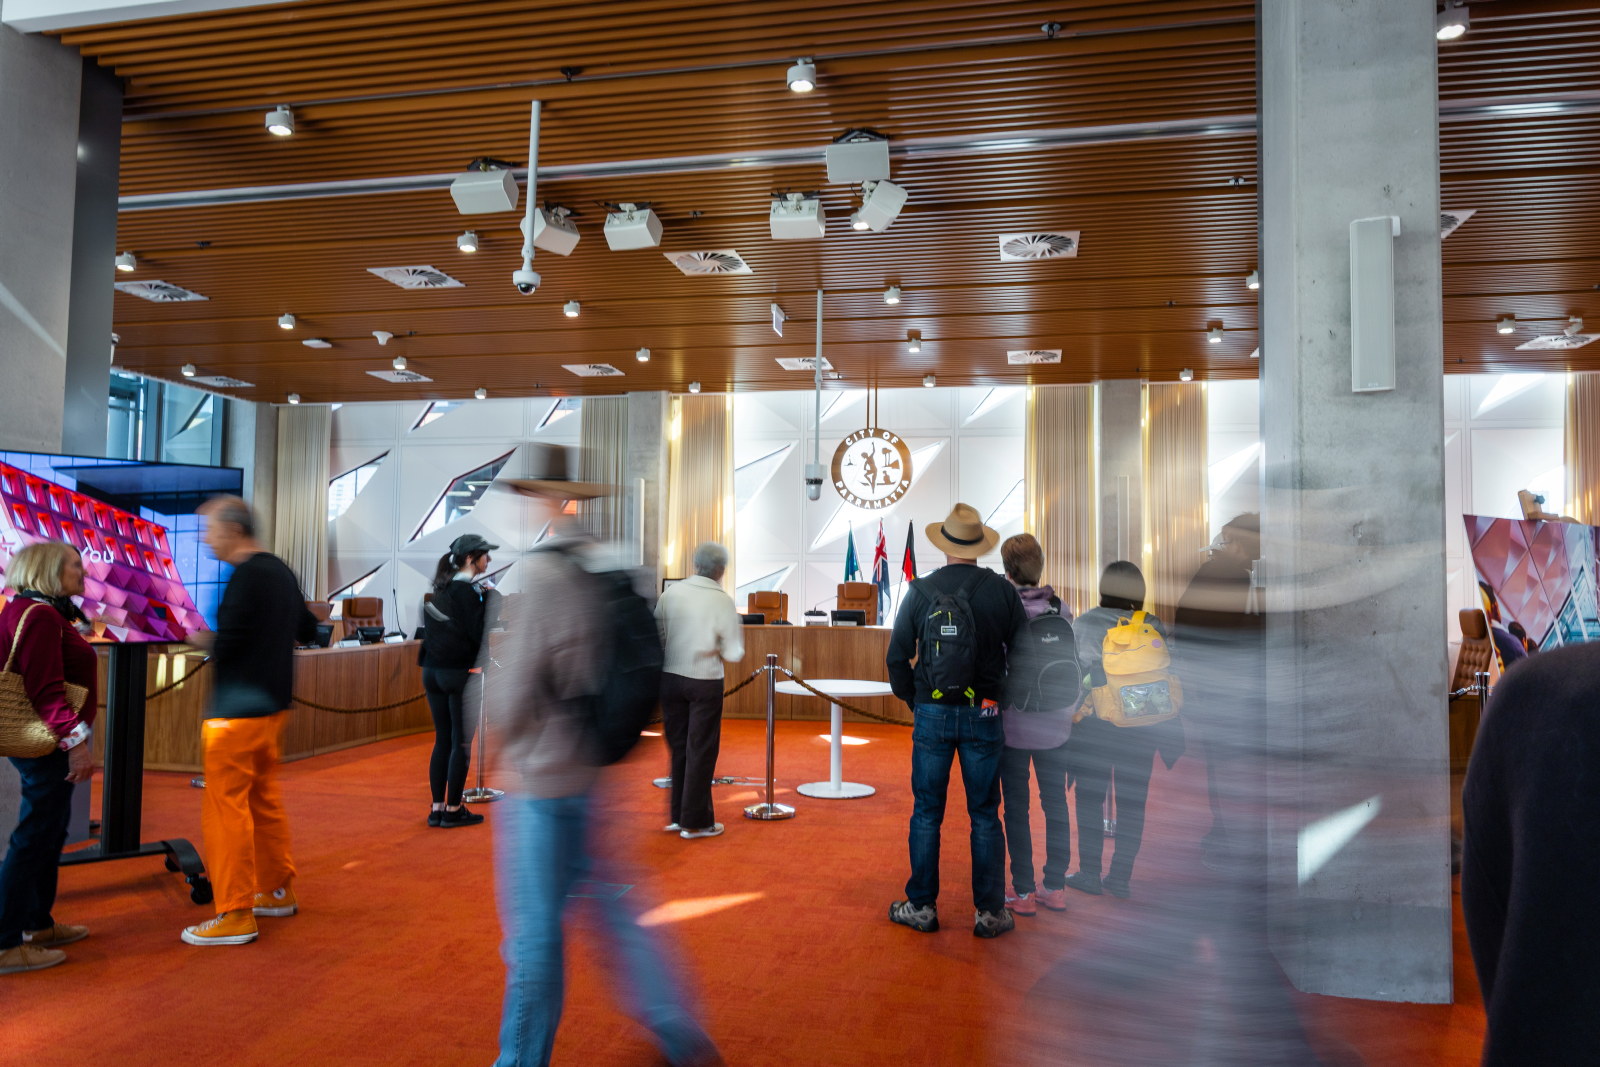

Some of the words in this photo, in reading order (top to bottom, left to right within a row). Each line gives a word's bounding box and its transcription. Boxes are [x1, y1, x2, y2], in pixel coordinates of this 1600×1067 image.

[845, 428, 875, 446] CITY
[883, 431, 899, 444] OF
[835, 480, 909, 509] PARRAMATTA
